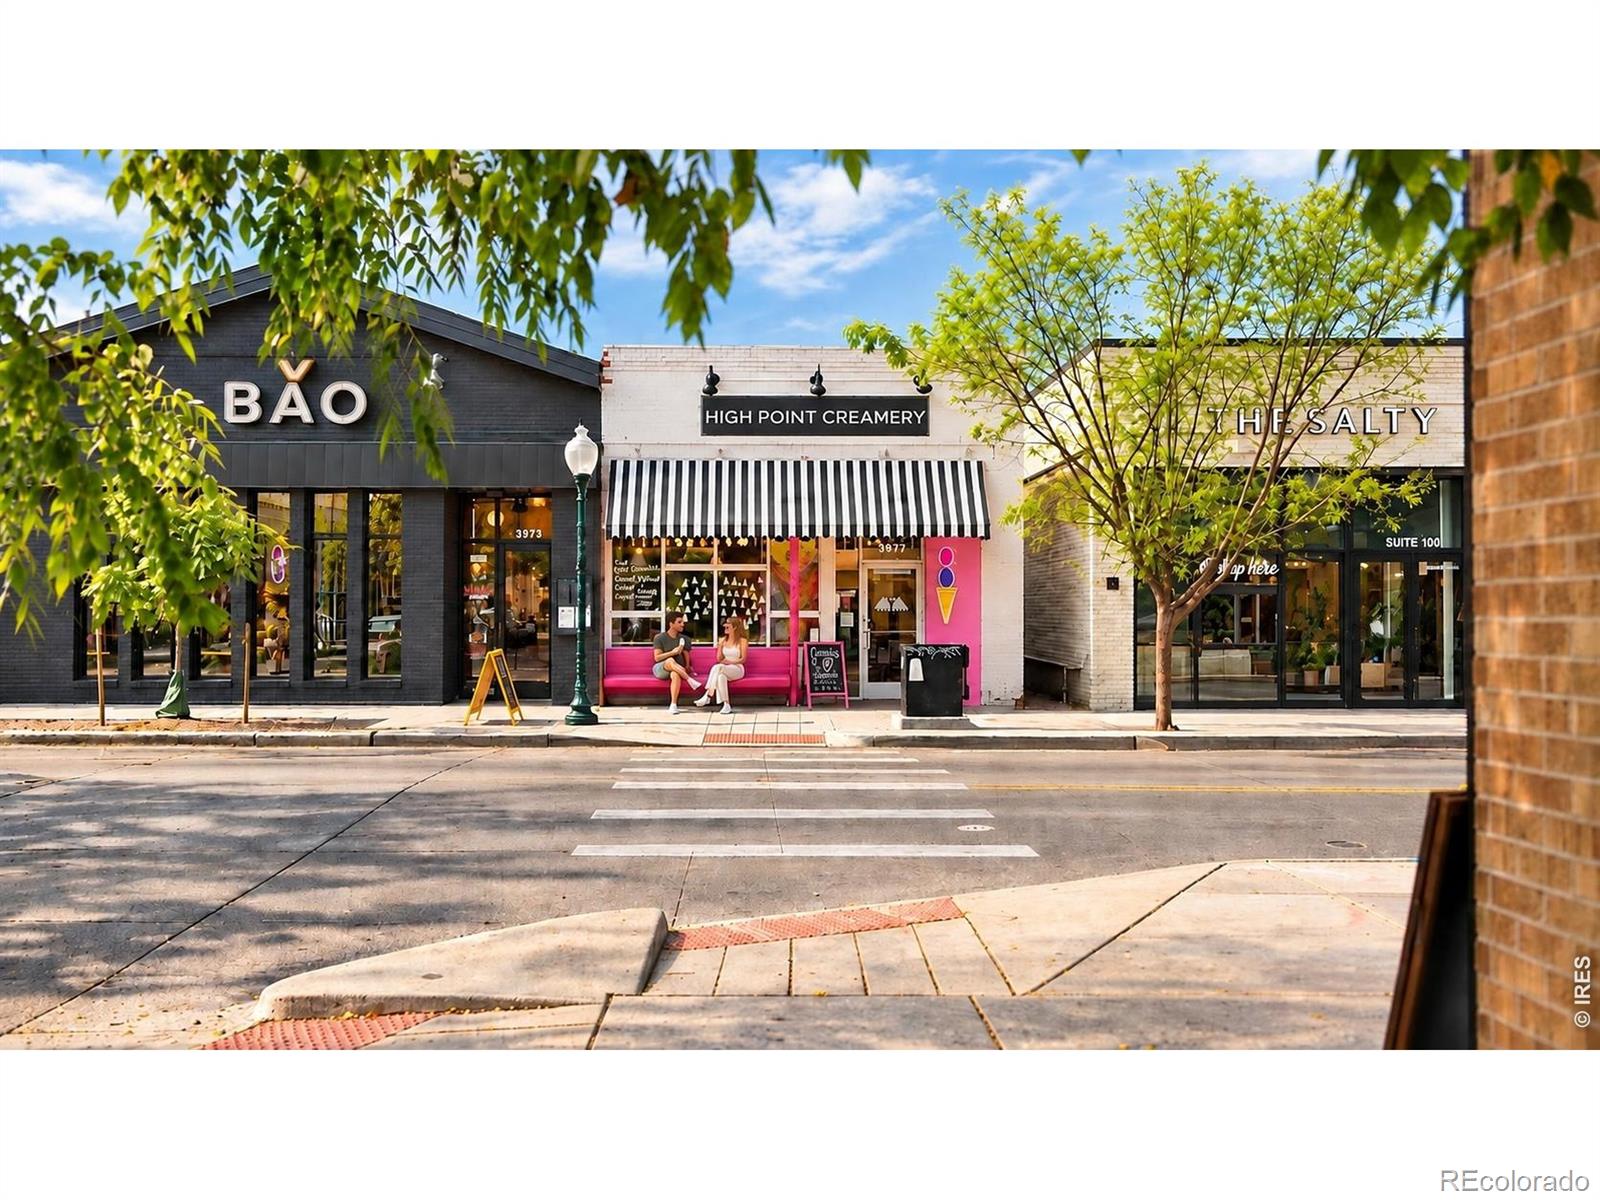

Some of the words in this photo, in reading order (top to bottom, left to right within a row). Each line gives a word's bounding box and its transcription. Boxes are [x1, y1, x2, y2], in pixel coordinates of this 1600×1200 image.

[705, 410, 752, 424] HIGH
[758, 410, 817, 424] POINT
[822, 410, 926, 424] CREAMERY
[1207, 406, 1294, 435] THE
[1306, 406, 1438, 435] SALTY
[515, 528, 543, 539] 3973
[1385, 537, 1418, 548] SUITE
[1421, 537, 1440, 548] 100
[1247, 555, 1280, 575] here
